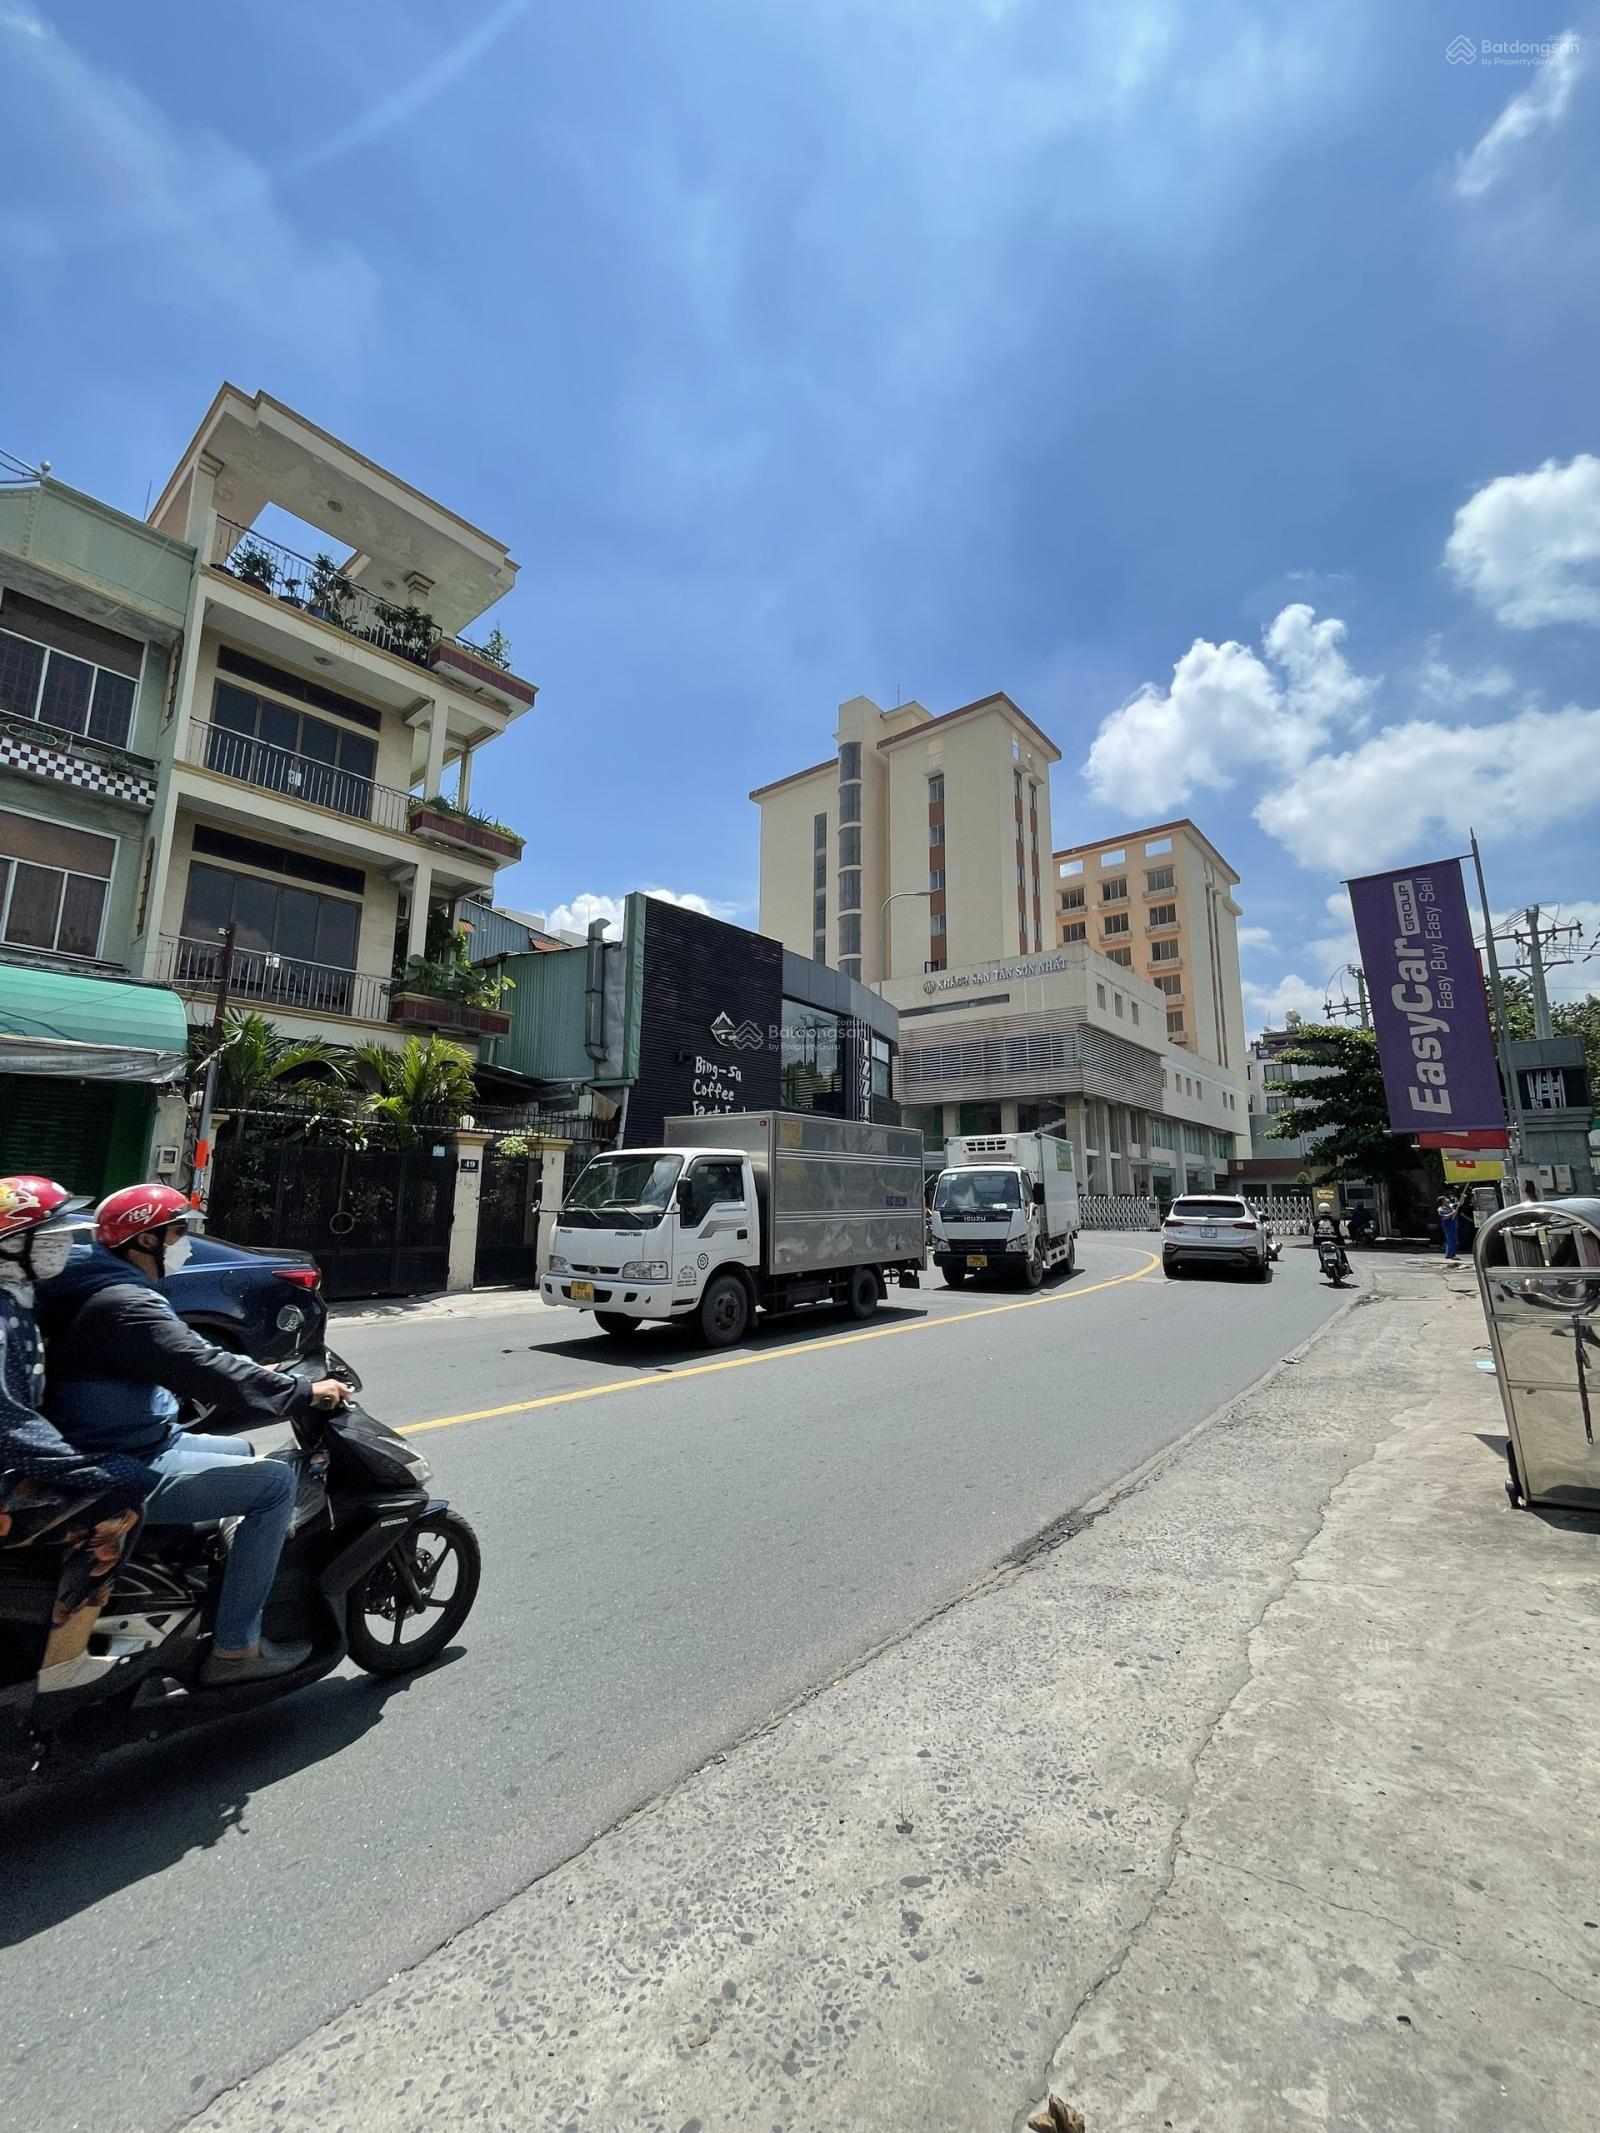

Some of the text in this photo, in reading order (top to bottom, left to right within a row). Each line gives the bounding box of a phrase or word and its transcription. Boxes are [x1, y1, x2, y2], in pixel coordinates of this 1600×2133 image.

[1399, 885, 1415, 932] GROUP
[1416, 877, 1454, 1009] Easy Buy Easy Sell
[1391, 937, 1453, 1115] EasyCar
[693, 1078, 735, 1101] Coffee
[128, 1203, 153, 1223] itel
